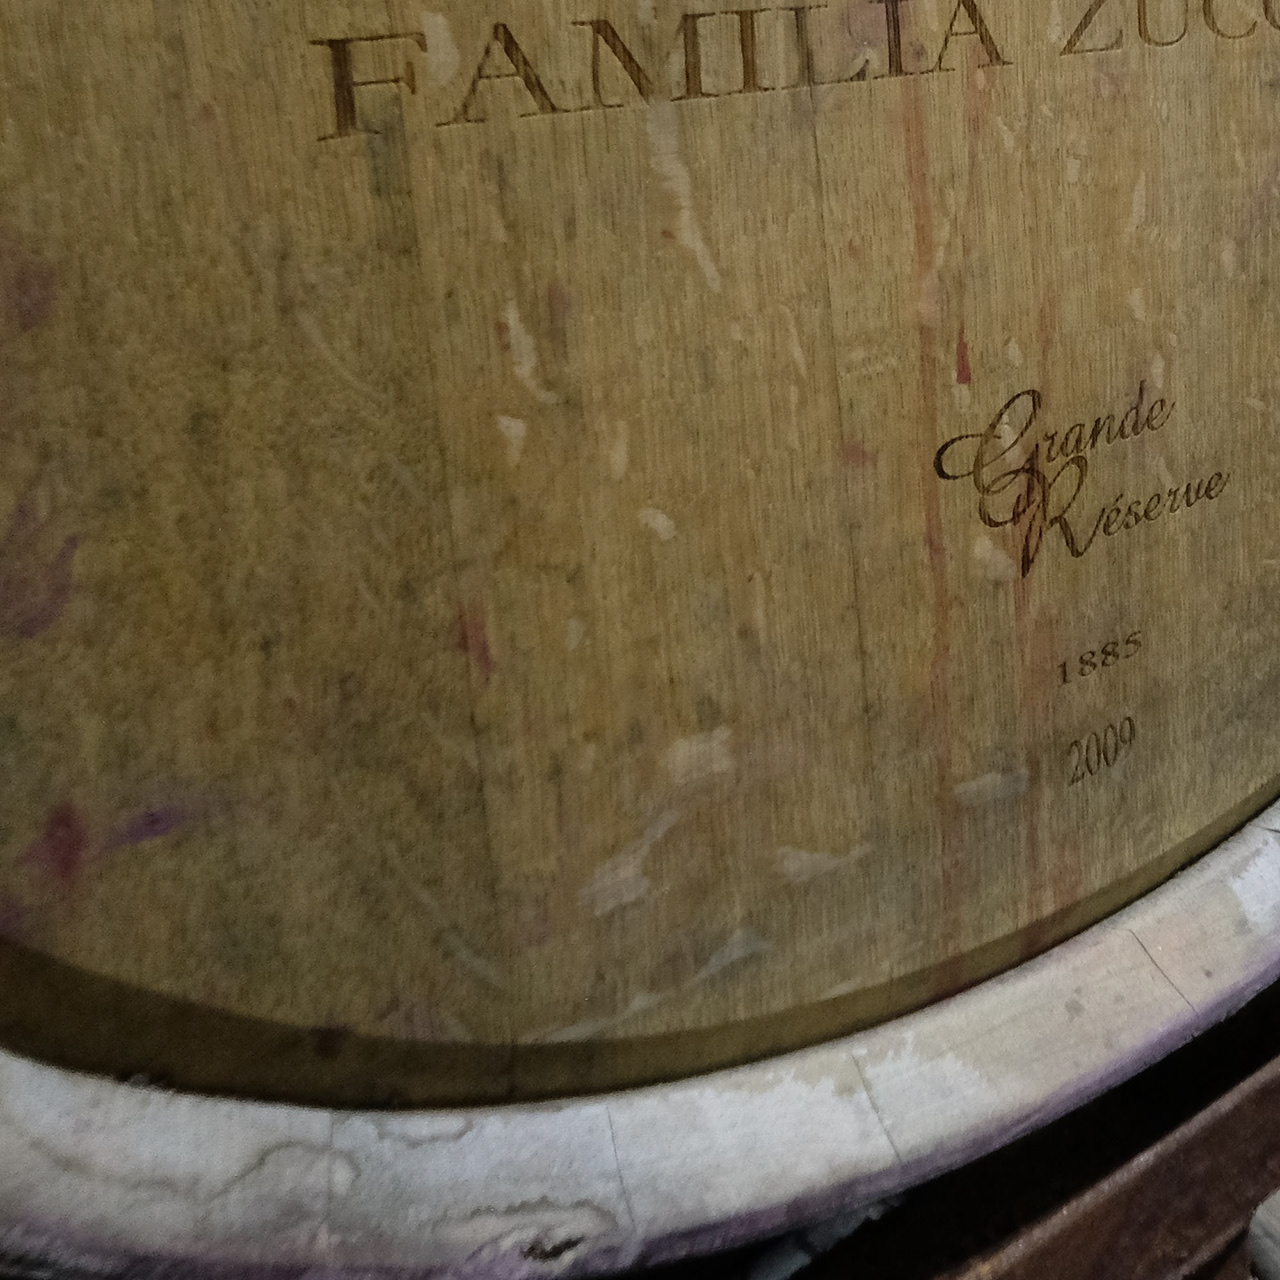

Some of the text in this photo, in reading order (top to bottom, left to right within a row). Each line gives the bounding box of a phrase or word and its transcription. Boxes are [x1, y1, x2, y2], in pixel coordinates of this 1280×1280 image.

[932, 379, 1177, 528] Grande
[977, 454, 1232, 579] Réserve
[1056, 629, 1143, 688] 1885
